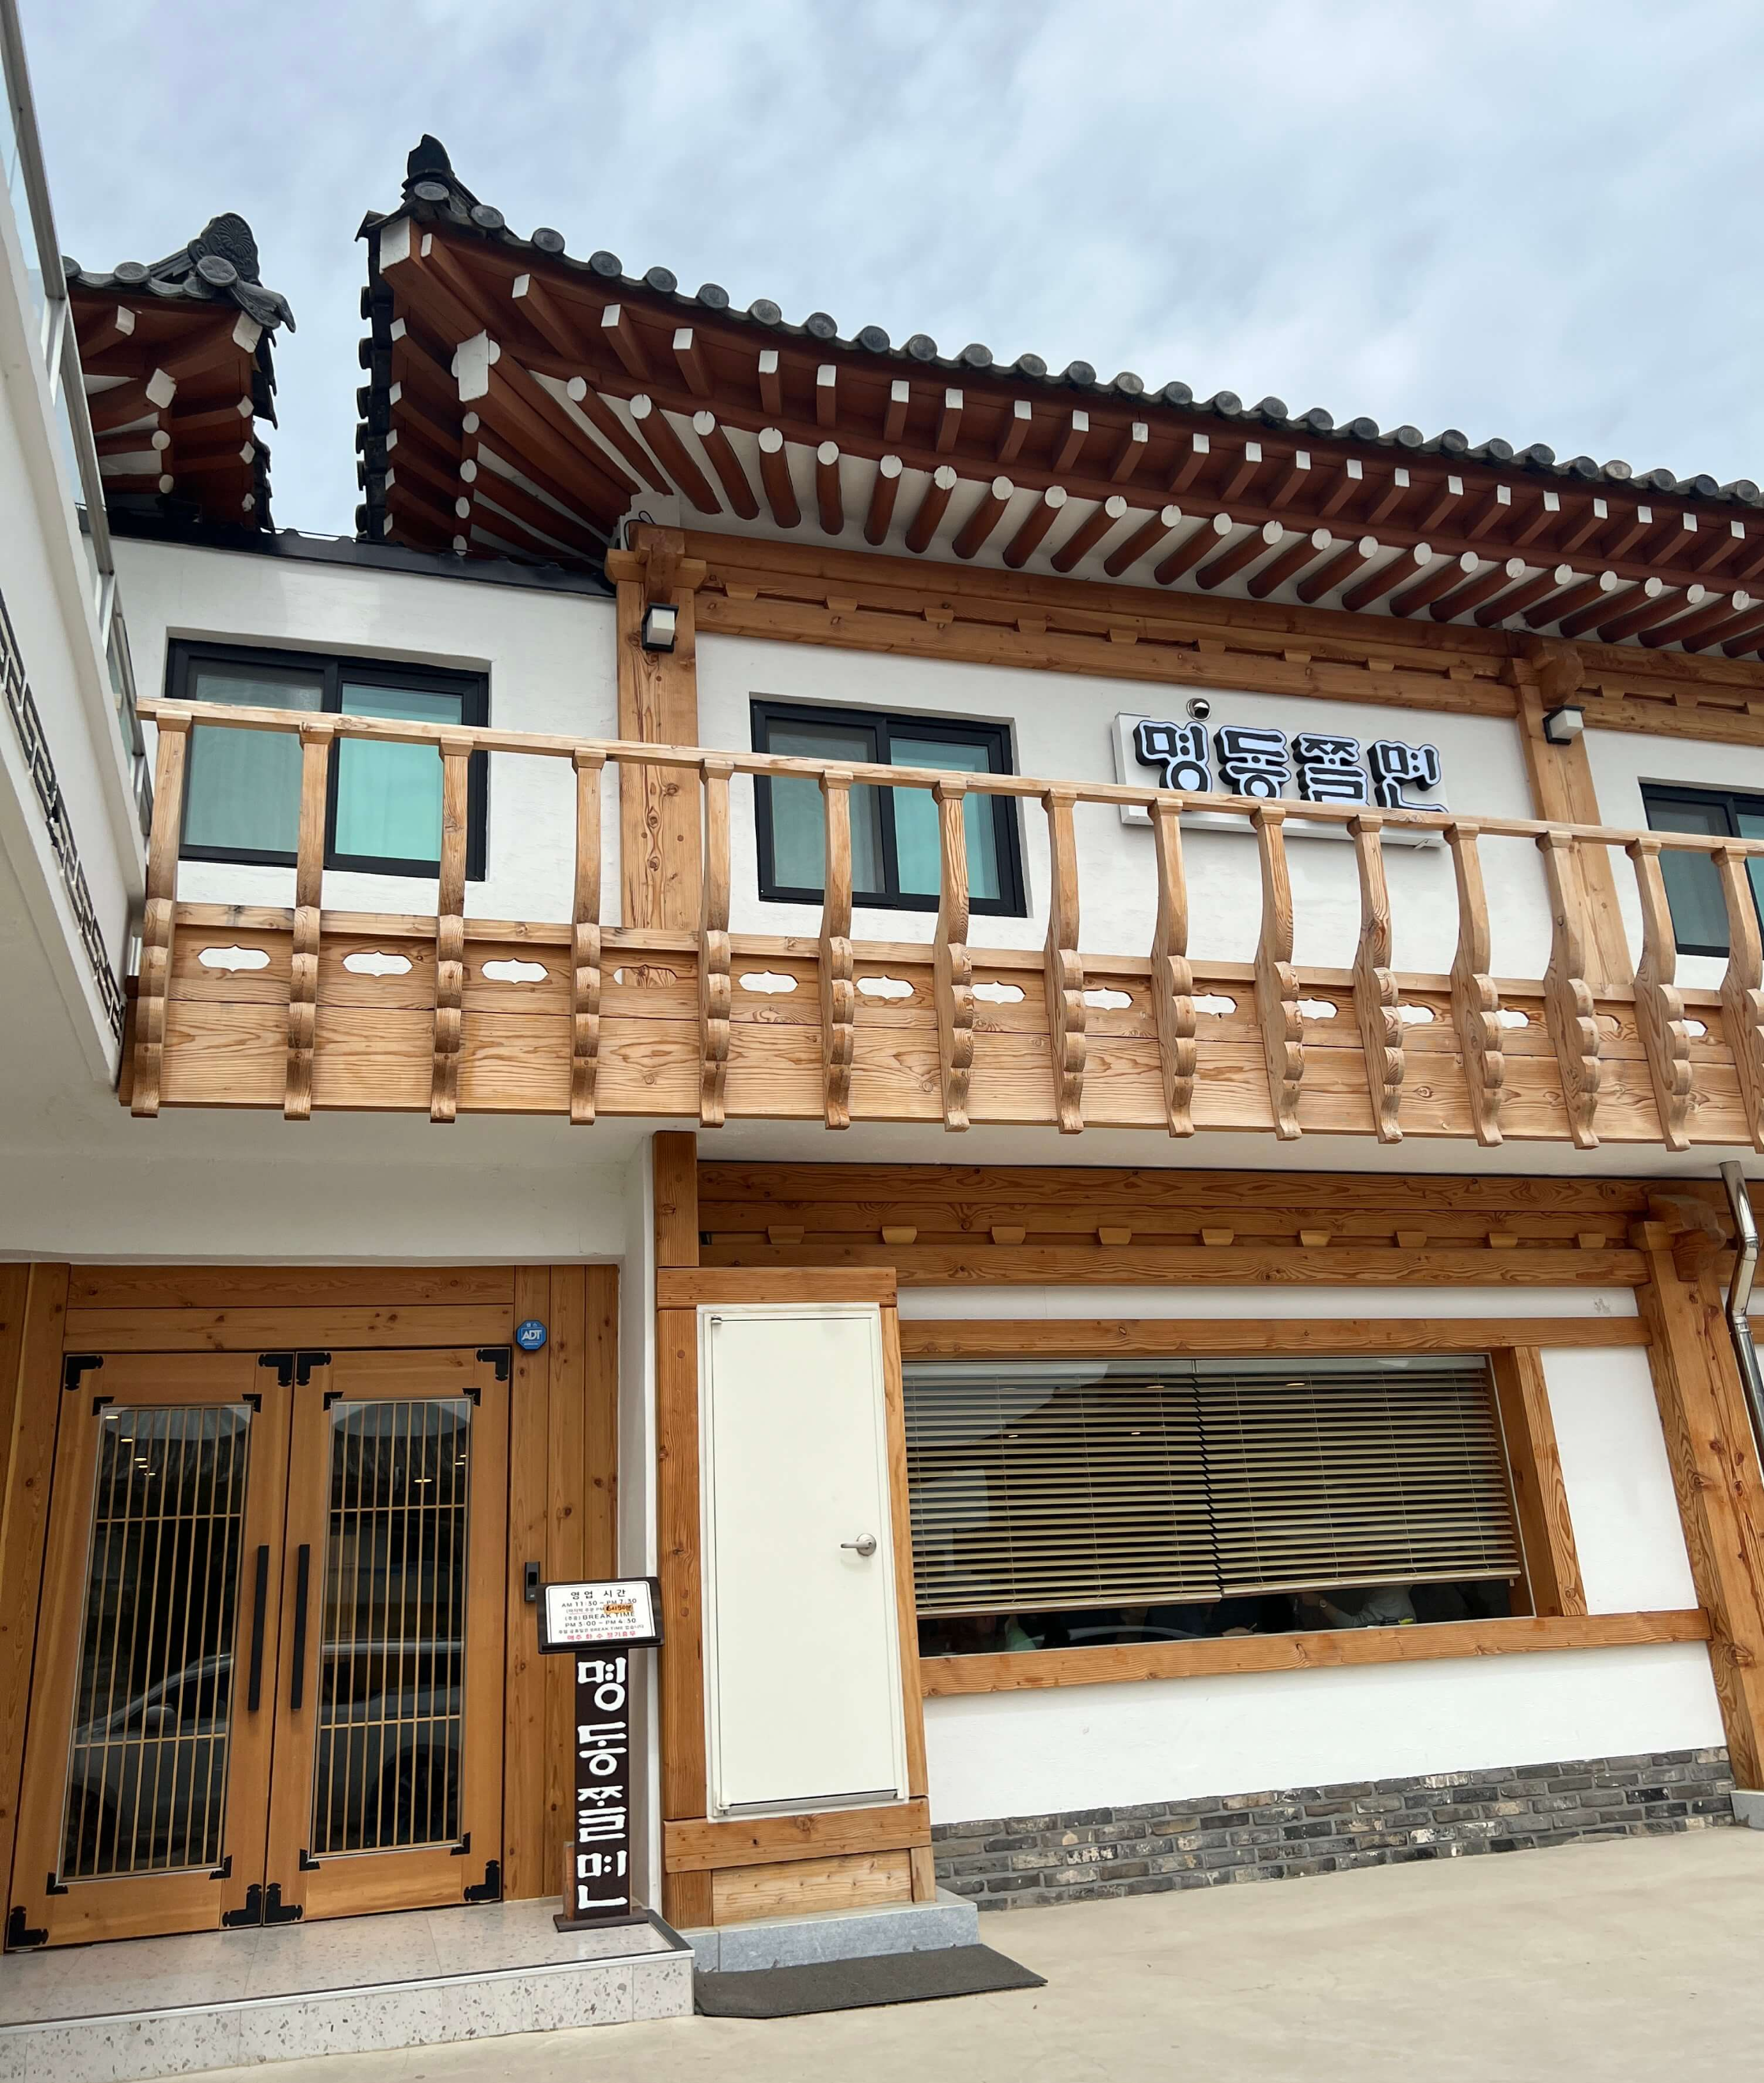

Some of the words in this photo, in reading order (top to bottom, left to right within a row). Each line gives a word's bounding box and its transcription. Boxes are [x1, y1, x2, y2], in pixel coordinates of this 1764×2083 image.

[1133, 720, 1449, 813] 명동쫄면
[521, 1330, 542, 1341] ADT
[571, 1590, 593, 1599] 영업
[577, 1656, 627, 1910] 명동쫄면
